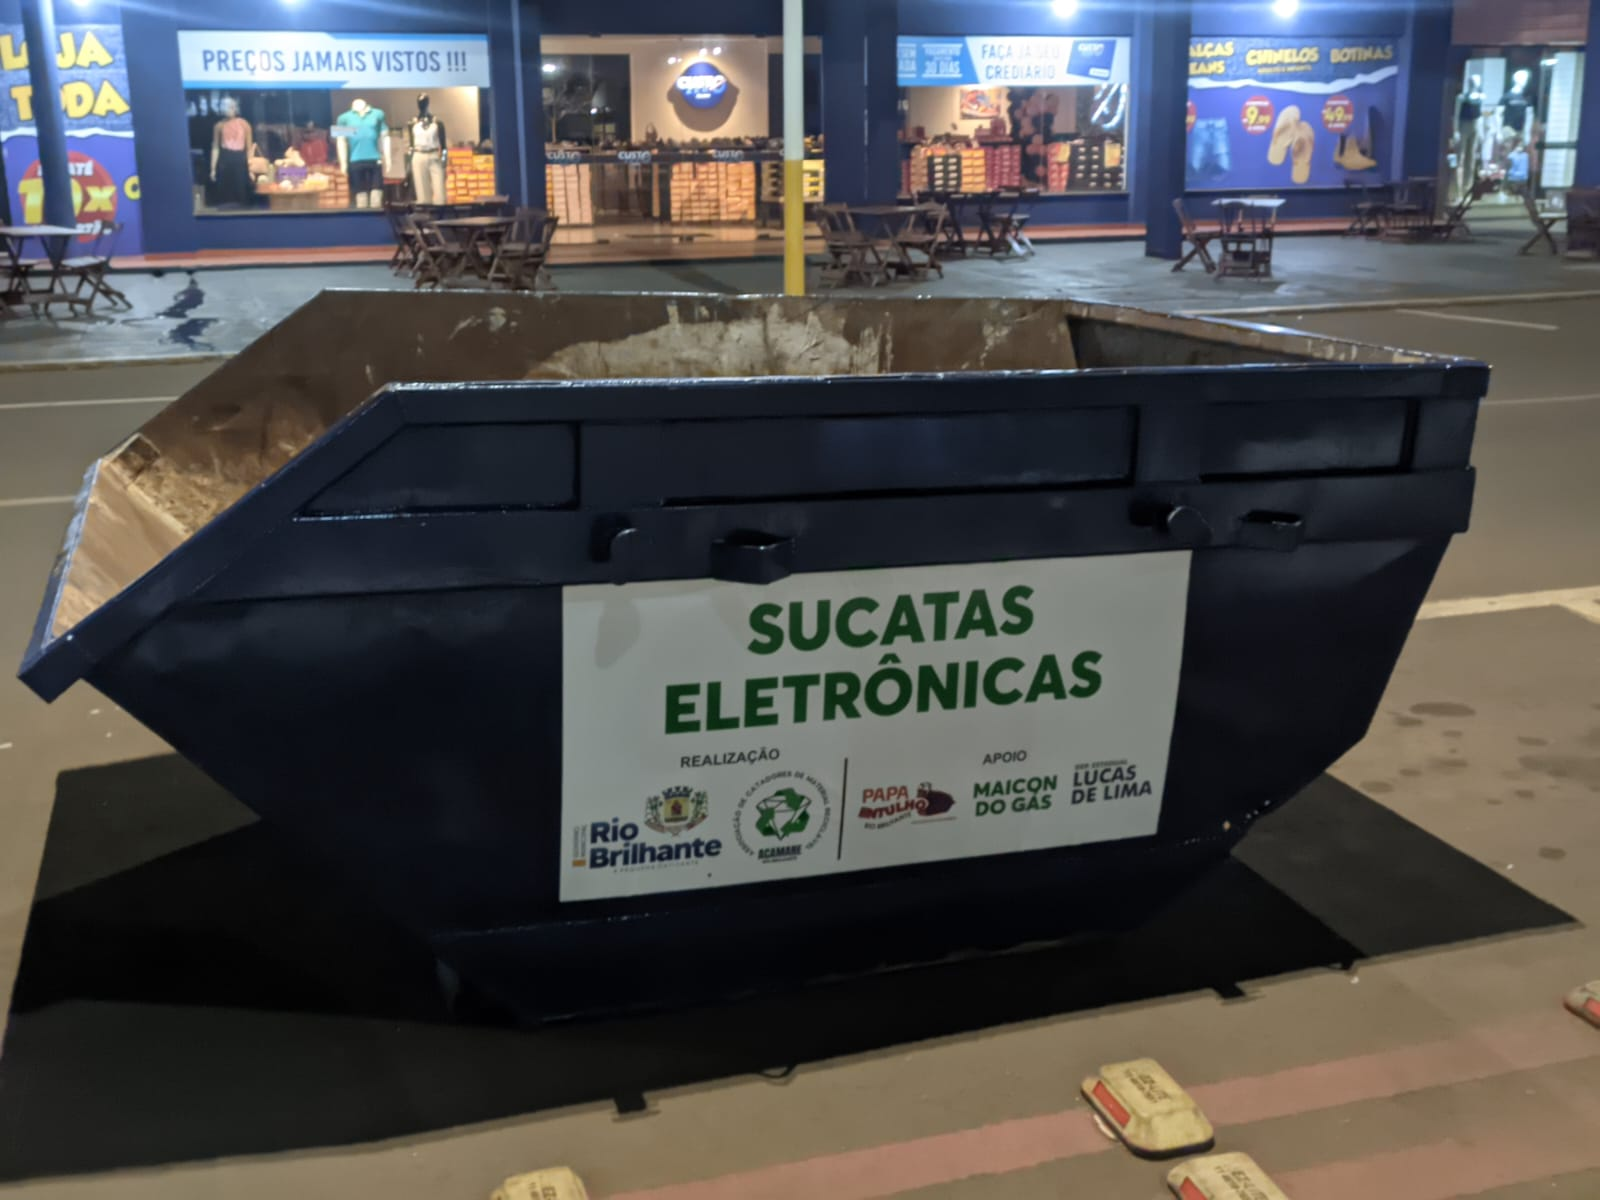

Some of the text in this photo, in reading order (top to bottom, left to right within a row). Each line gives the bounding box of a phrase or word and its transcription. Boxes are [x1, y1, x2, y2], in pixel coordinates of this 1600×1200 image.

[0, 31, 114, 70] LJA
[203, 50, 468, 75] PREÇOS JAMAIS VISTOS !!!
[981, 44, 1010, 61] FAÇA
[1330, 46, 1393, 63] BOTINAS
[10, 80, 131, 120] TDA
[747, 585, 1034, 655] SUCATAS
[665, 651, 1102, 734] ELETRÔNICAS
[680, 747, 780, 769] REALIZAÇÃO
[982, 750, 1027, 765] APOIO
[973, 774, 1058, 799] MAICON
[1073, 764, 1137, 787] LUCAS
[862, 785, 909, 804] PAPA
[1071, 780, 1152, 805] DE LIMA
[975, 799, 1006, 817] DO
[590, 816, 639, 844] Rio
[589, 838, 722, 869] Brilhante
